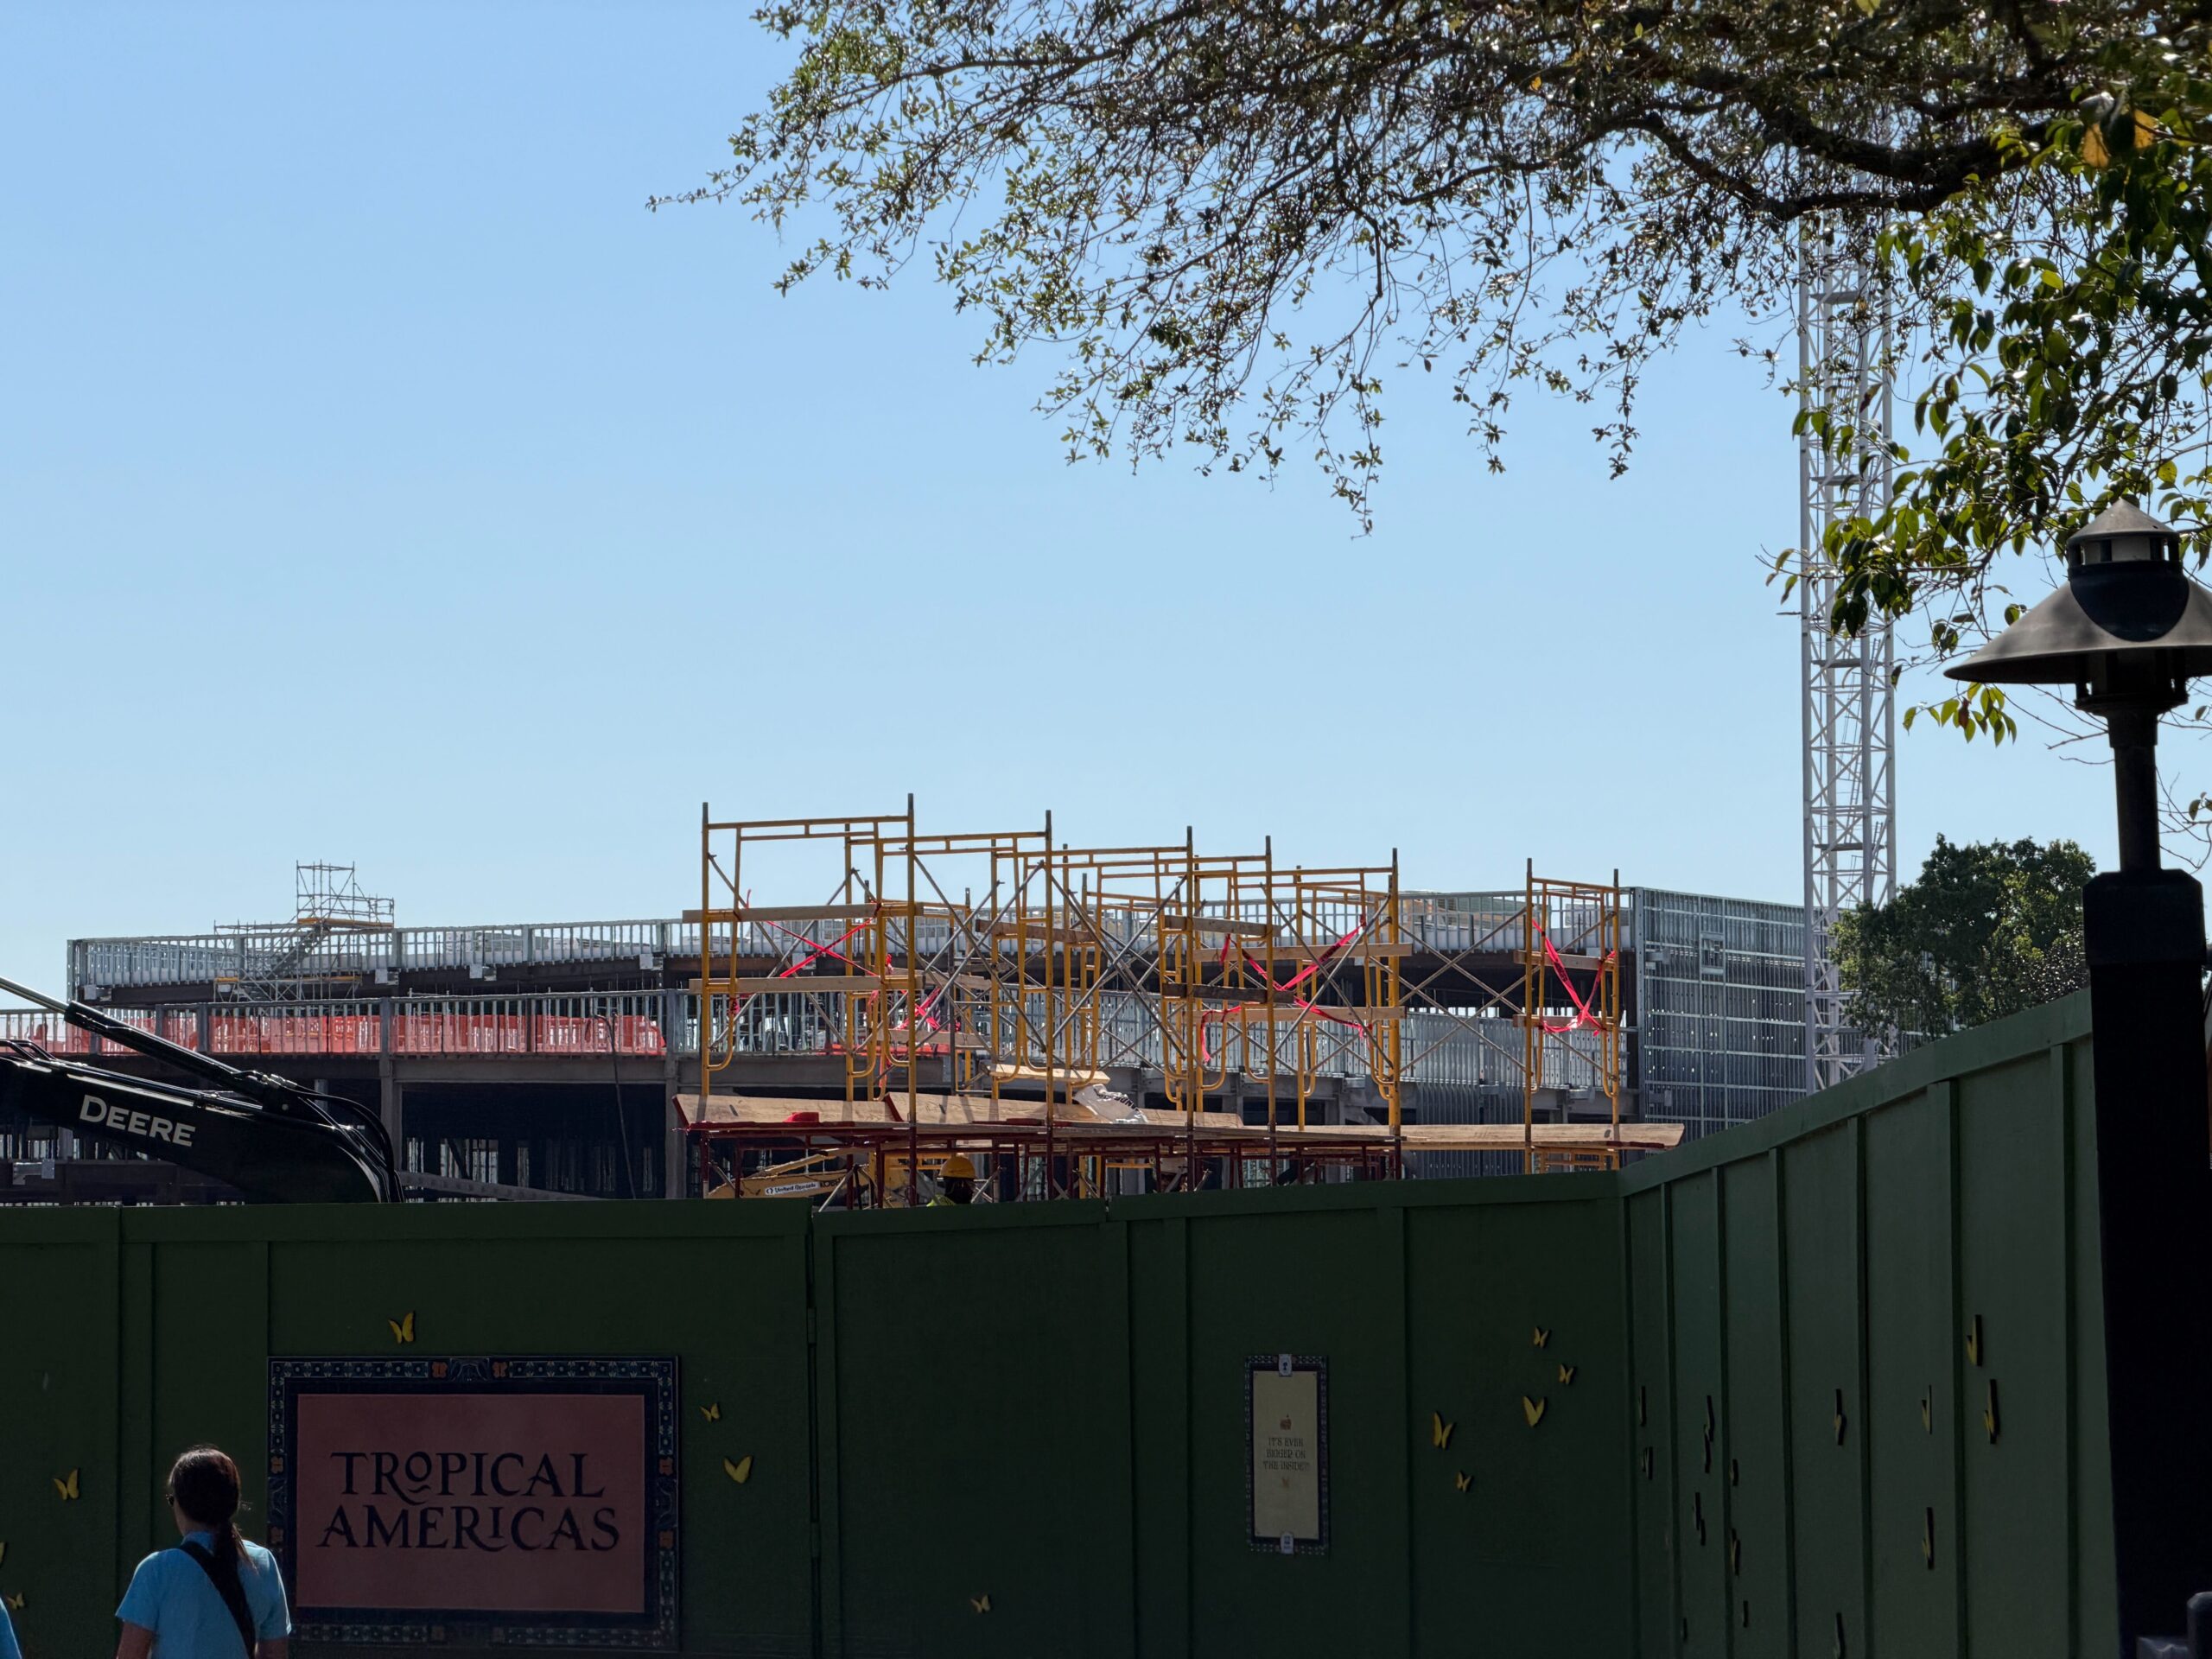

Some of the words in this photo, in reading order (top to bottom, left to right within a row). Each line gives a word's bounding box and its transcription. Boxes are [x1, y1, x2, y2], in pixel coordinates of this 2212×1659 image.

[79, 1094, 196, 1147] DEERE
[330, 1451, 605, 1505] TROPICAL
[315, 1504, 620, 1552] AMERICAS
